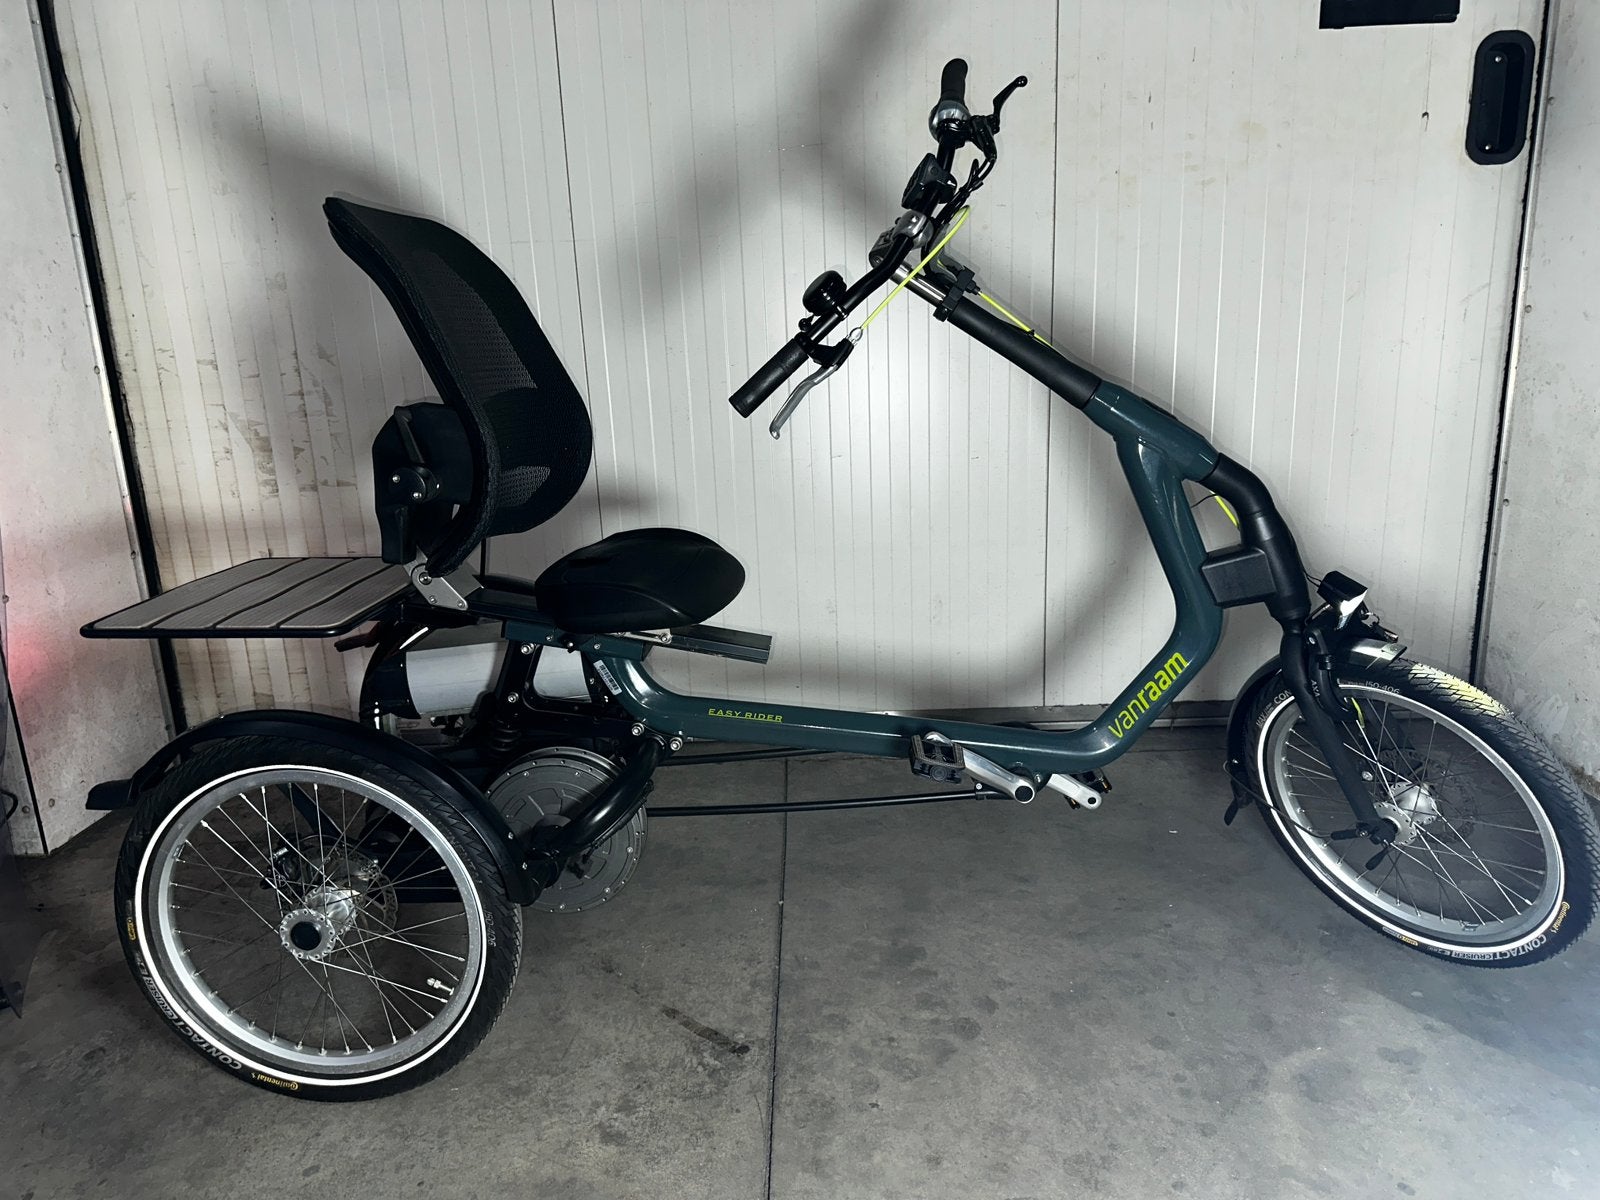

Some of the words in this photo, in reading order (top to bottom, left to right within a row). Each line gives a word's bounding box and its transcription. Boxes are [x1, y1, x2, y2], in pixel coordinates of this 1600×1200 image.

[1107, 652, 1189, 738] vanraam
[708, 708, 741, 718] EASY
[744, 711, 783, 723] RIDER
[1453, 950, 1492, 961] CRUISER
[1493, 934, 1547, 960] CONTACT
[143, 976, 175, 1018] CRUISER
[172, 1017, 242, 1070] CONTACT
[257, 1073, 299, 1091] Continental
